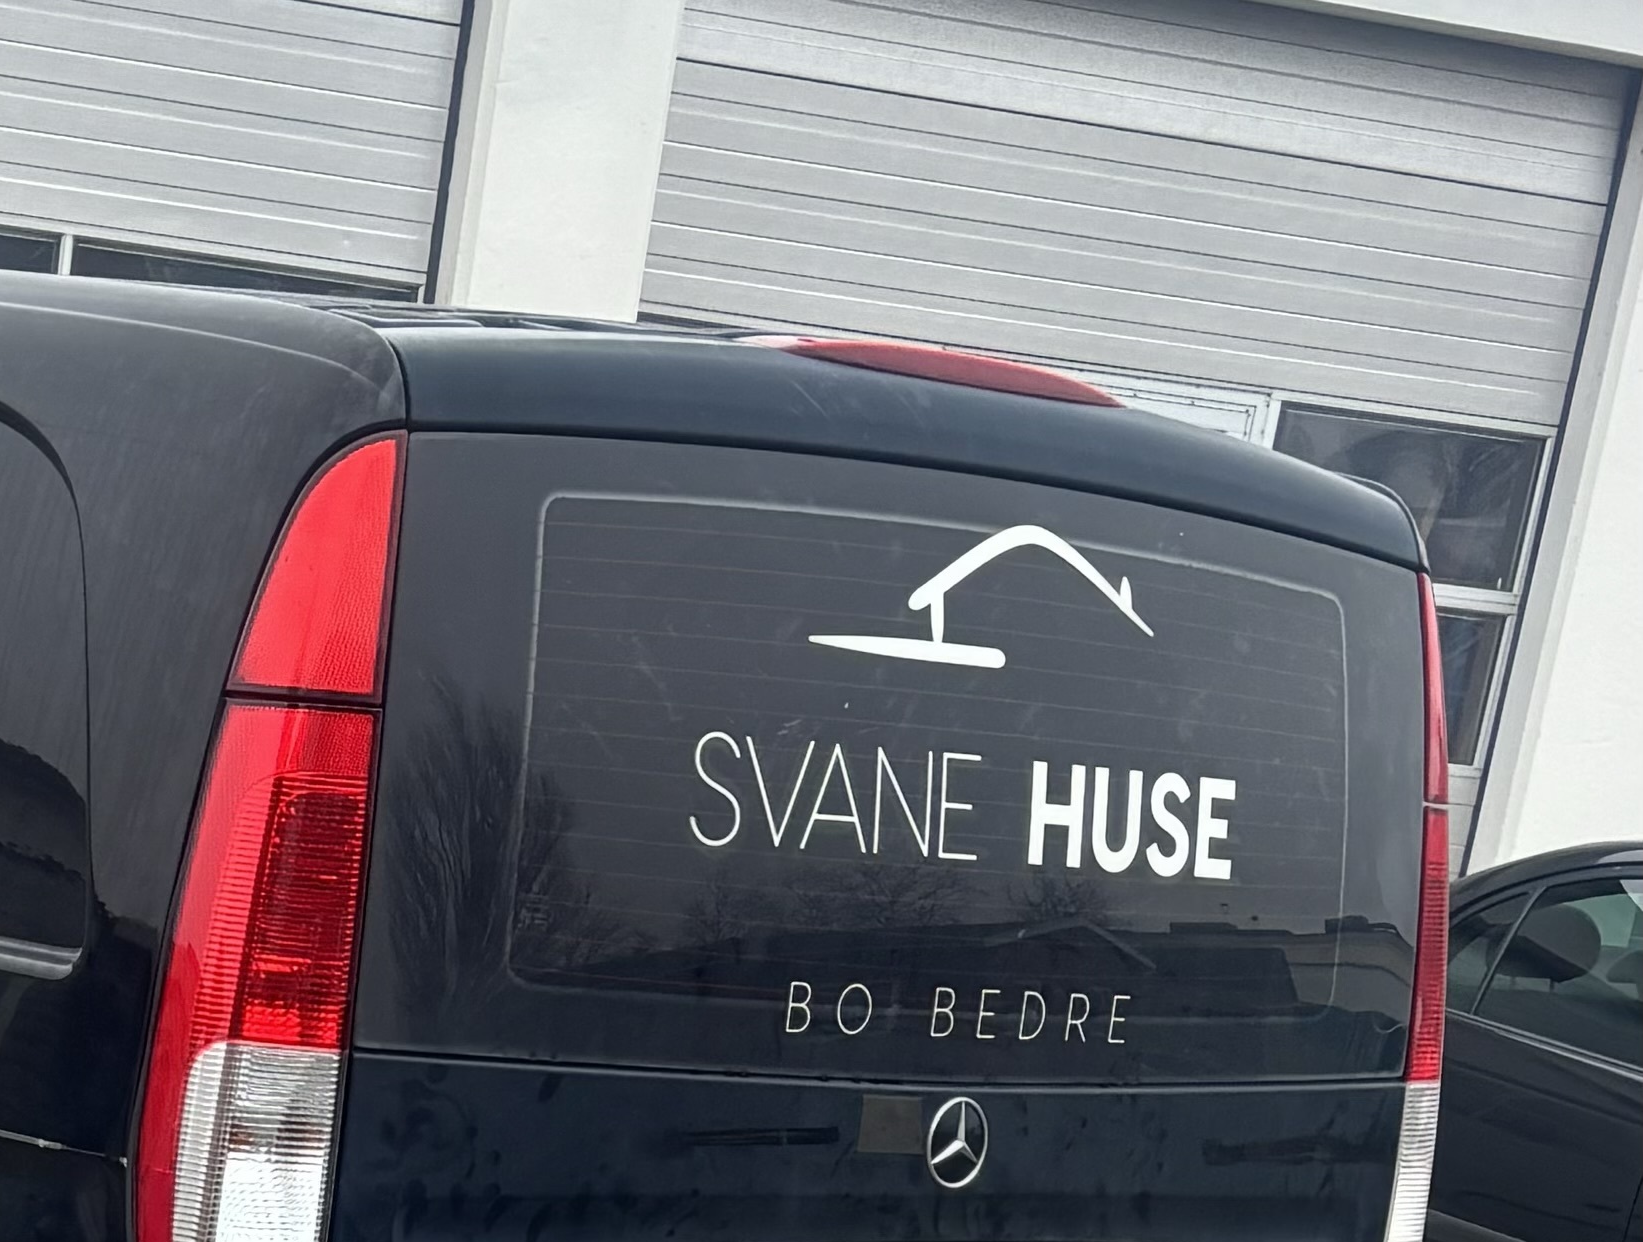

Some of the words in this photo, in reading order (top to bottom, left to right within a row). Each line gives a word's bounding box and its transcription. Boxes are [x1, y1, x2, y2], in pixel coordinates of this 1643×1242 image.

[689, 731, 983, 861] SVANE
[1027, 760, 1237, 880] HUSE
[785, 981, 873, 1035] BO
[930, 986, 1131, 1044] BEDRE
